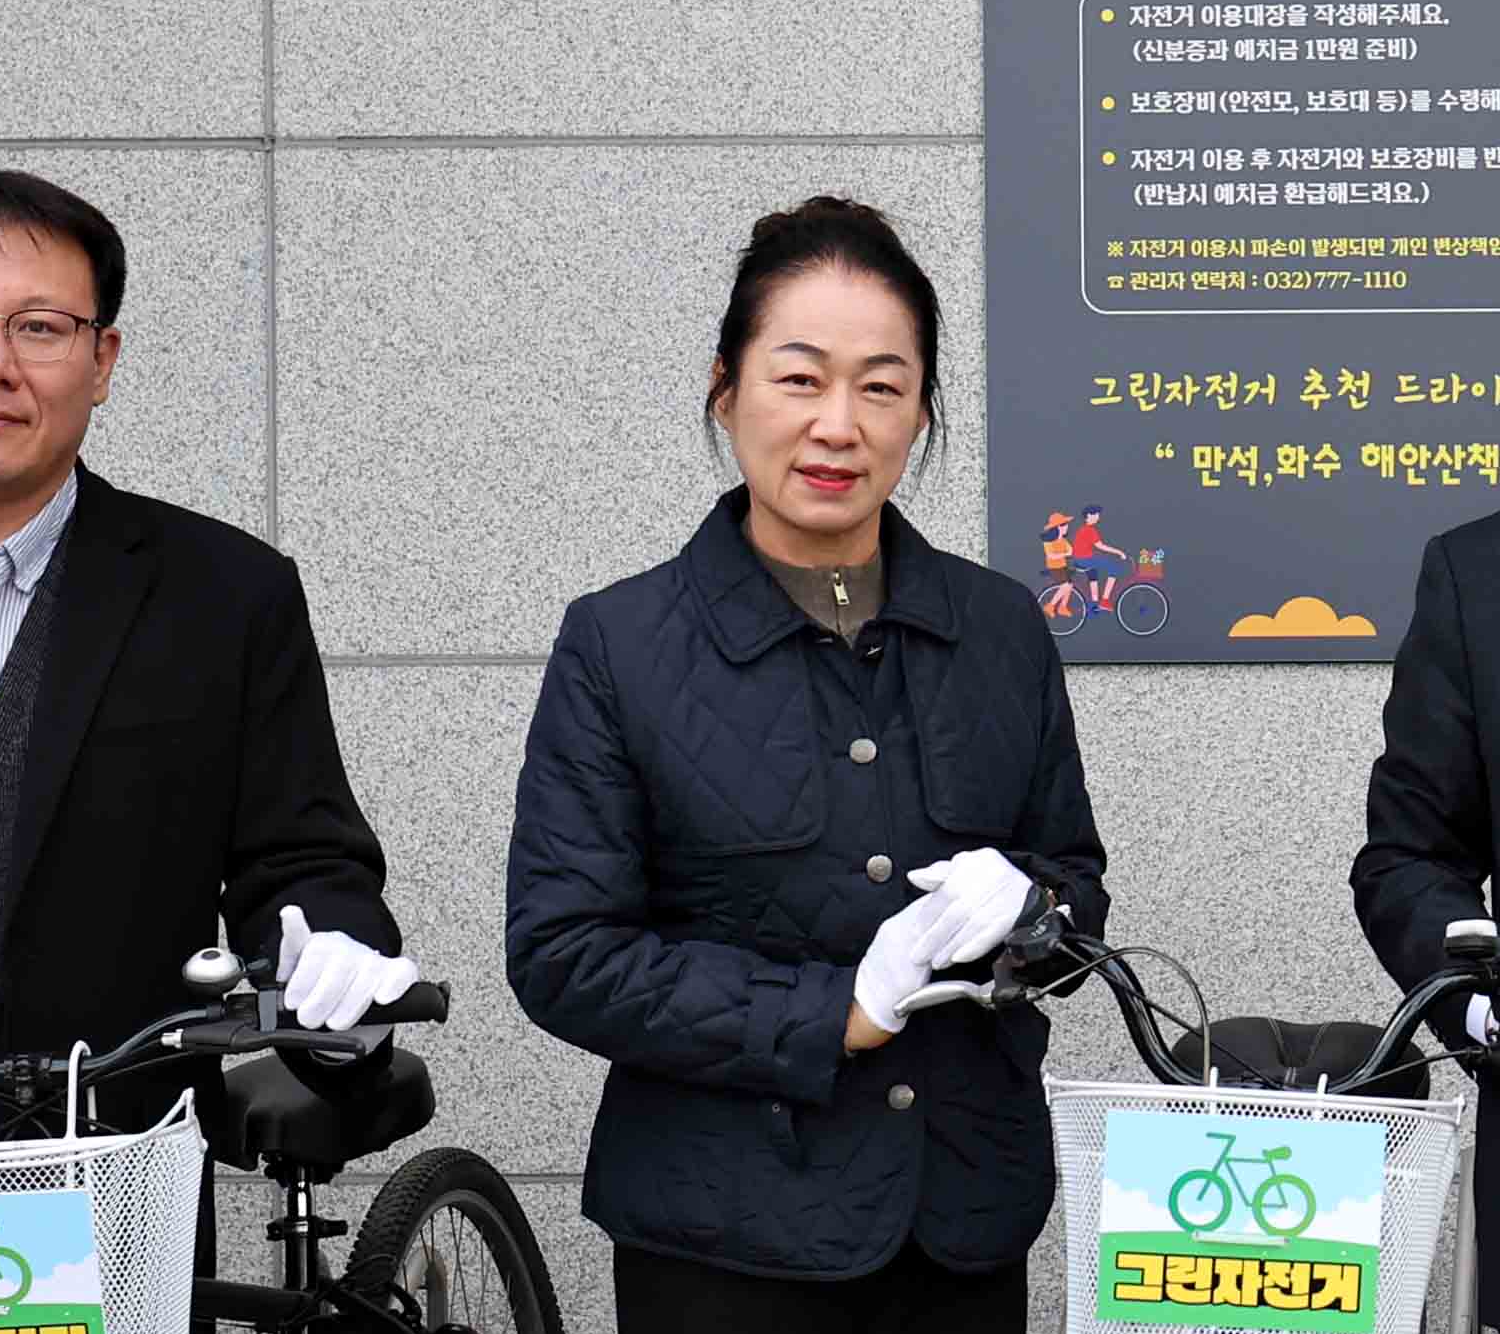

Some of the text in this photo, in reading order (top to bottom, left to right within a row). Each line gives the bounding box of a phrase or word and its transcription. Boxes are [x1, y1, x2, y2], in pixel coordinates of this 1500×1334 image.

[1129, 2, 1450, 28] 자전거 이용대장을 작성해주세요.
[1133, 37, 1418, 62] (신분증과 예치금 1만원 준비)
[1130, 90, 1300, 115] 보호장비(안전모,
[1305, 89, 1370, 112] 보호대
[1375, 89, 1432, 113] 등)를
[1130, 148, 1195, 172] 자전거
[1202, 148, 1245, 172] 이용
[1249, 147, 1273, 171] 후
[1277, 147, 1365, 171] 자전거와
[1369, 146, 1478, 170] 보호장비를
[1134, 181, 1430, 206] (반납시 예치금 환급해드려요.)
[1129, 239, 1185, 258] 자전거
[1190, 238, 1246, 258] 이용시
[1250, 238, 1306, 258] 파손이
[1311, 237, 1385, 258] 발생되면
[1390, 237, 1428, 256] 개인
[1129, 271, 1186, 291] 관리자
[1190, 270, 1246, 291] 연락처
[1263, 270, 1407, 290] 032)777-1110
[1090, 370, 1276, 412] 그린자전거
[1299, 367, 1370, 411] 추천
[1193, 443, 1342, 488] 만석,화수
[1114, 1251, 1362, 1313] 그린자전거
